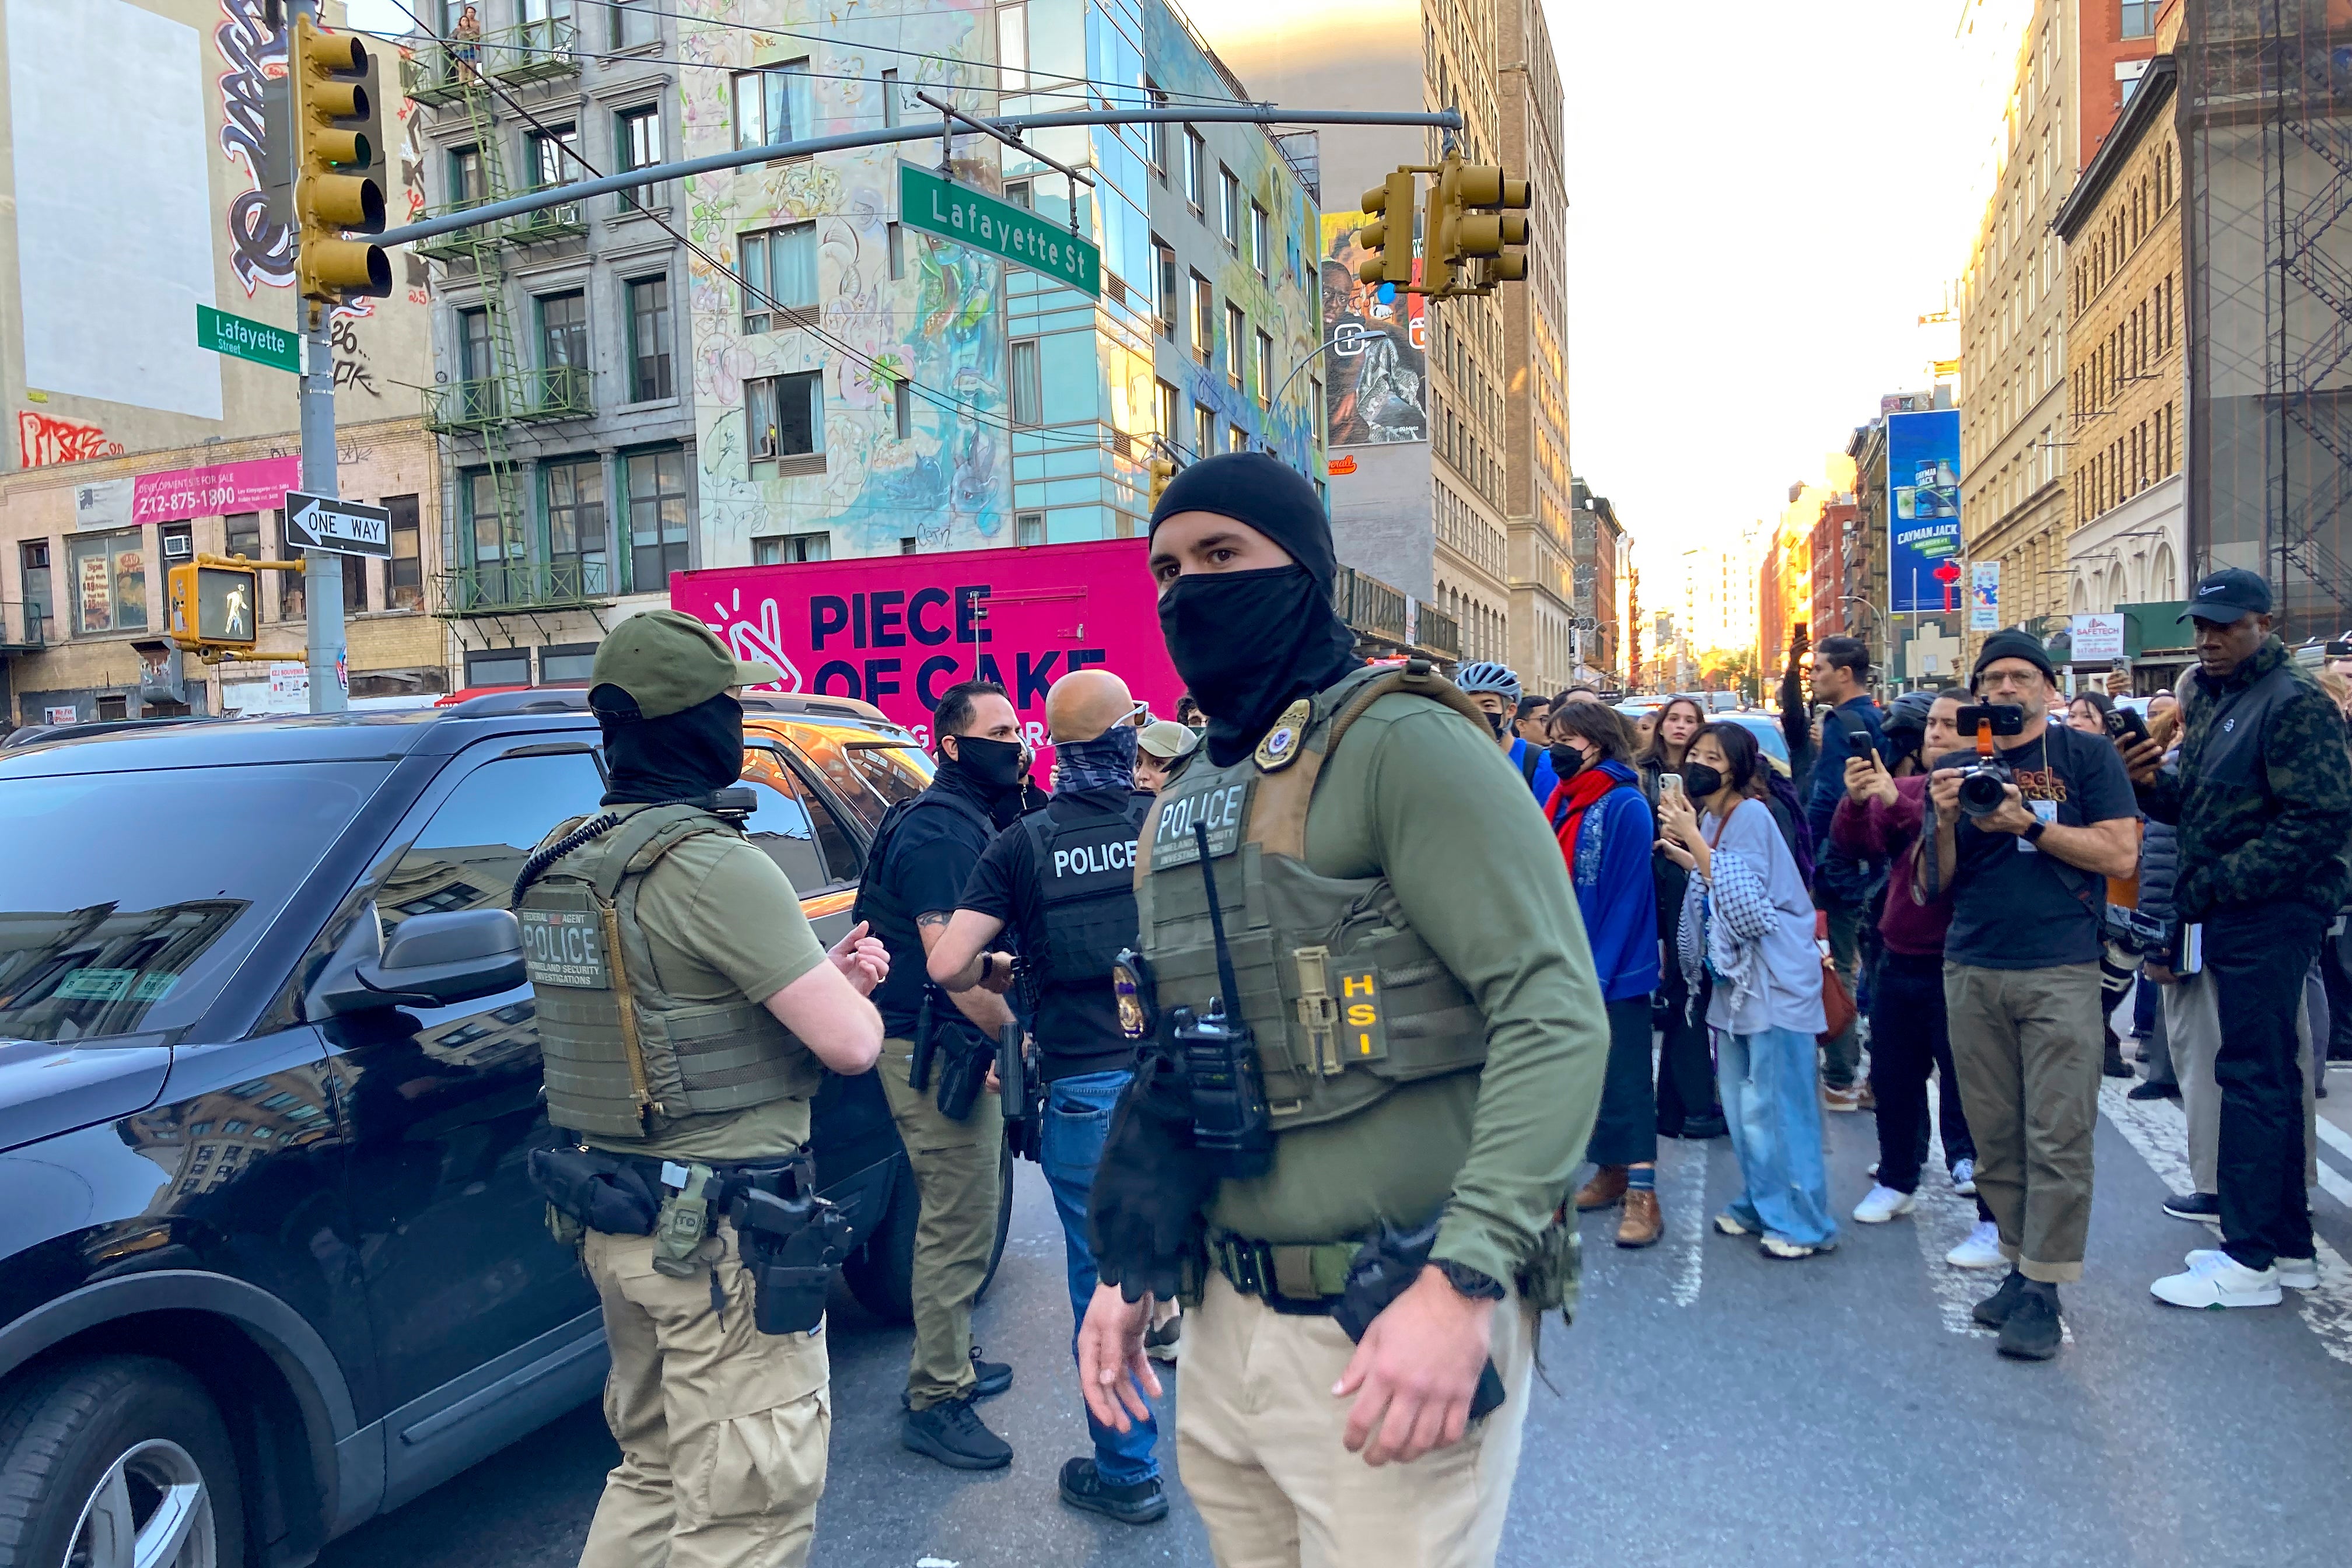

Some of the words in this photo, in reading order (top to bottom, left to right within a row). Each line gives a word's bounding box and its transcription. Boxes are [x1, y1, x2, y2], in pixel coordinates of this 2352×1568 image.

[932, 188, 1058, 266] Lafayette
[1065, 244, 1085, 279] St
[216, 315, 285, 354] Lafayette
[218, 338, 242, 355] Street
[1328, 455, 1353, 468] erall
[139, 478, 187, 494] DEVELOPMENT
[201, 475, 216, 485] FOR
[219, 473, 234, 483] SALE
[1915, 467, 1937, 481] CAYMAN
[1919, 476, 1934, 487] JACK
[139, 487, 235, 514] 212-875-1800
[309, 512, 338, 534] ONE
[351, 518, 380, 540] WAY
[1897, 526, 1933, 545] CAYMAN
[1933, 524, 1959, 537] JACK
[87, 563, 103, 572] Spa
[810, 583, 993, 651] PIECE
[813, 657, 902, 708] OF
[1157, 785, 1242, 844] POLICE
[1054, 840, 1138, 878] POLICE
[523, 912, 548, 922] FEDERAL
[562, 914, 584, 923] AGENT
[524, 925, 598, 965] POLICE
[527, 961, 561, 973] HOMELAND
[562, 964, 600, 975] SECURITY
[535, 971, 591, 985] INVESTIGATIONS
[108, 981, 123, 991] 27
[1343, 974, 1377, 1055] HSI
